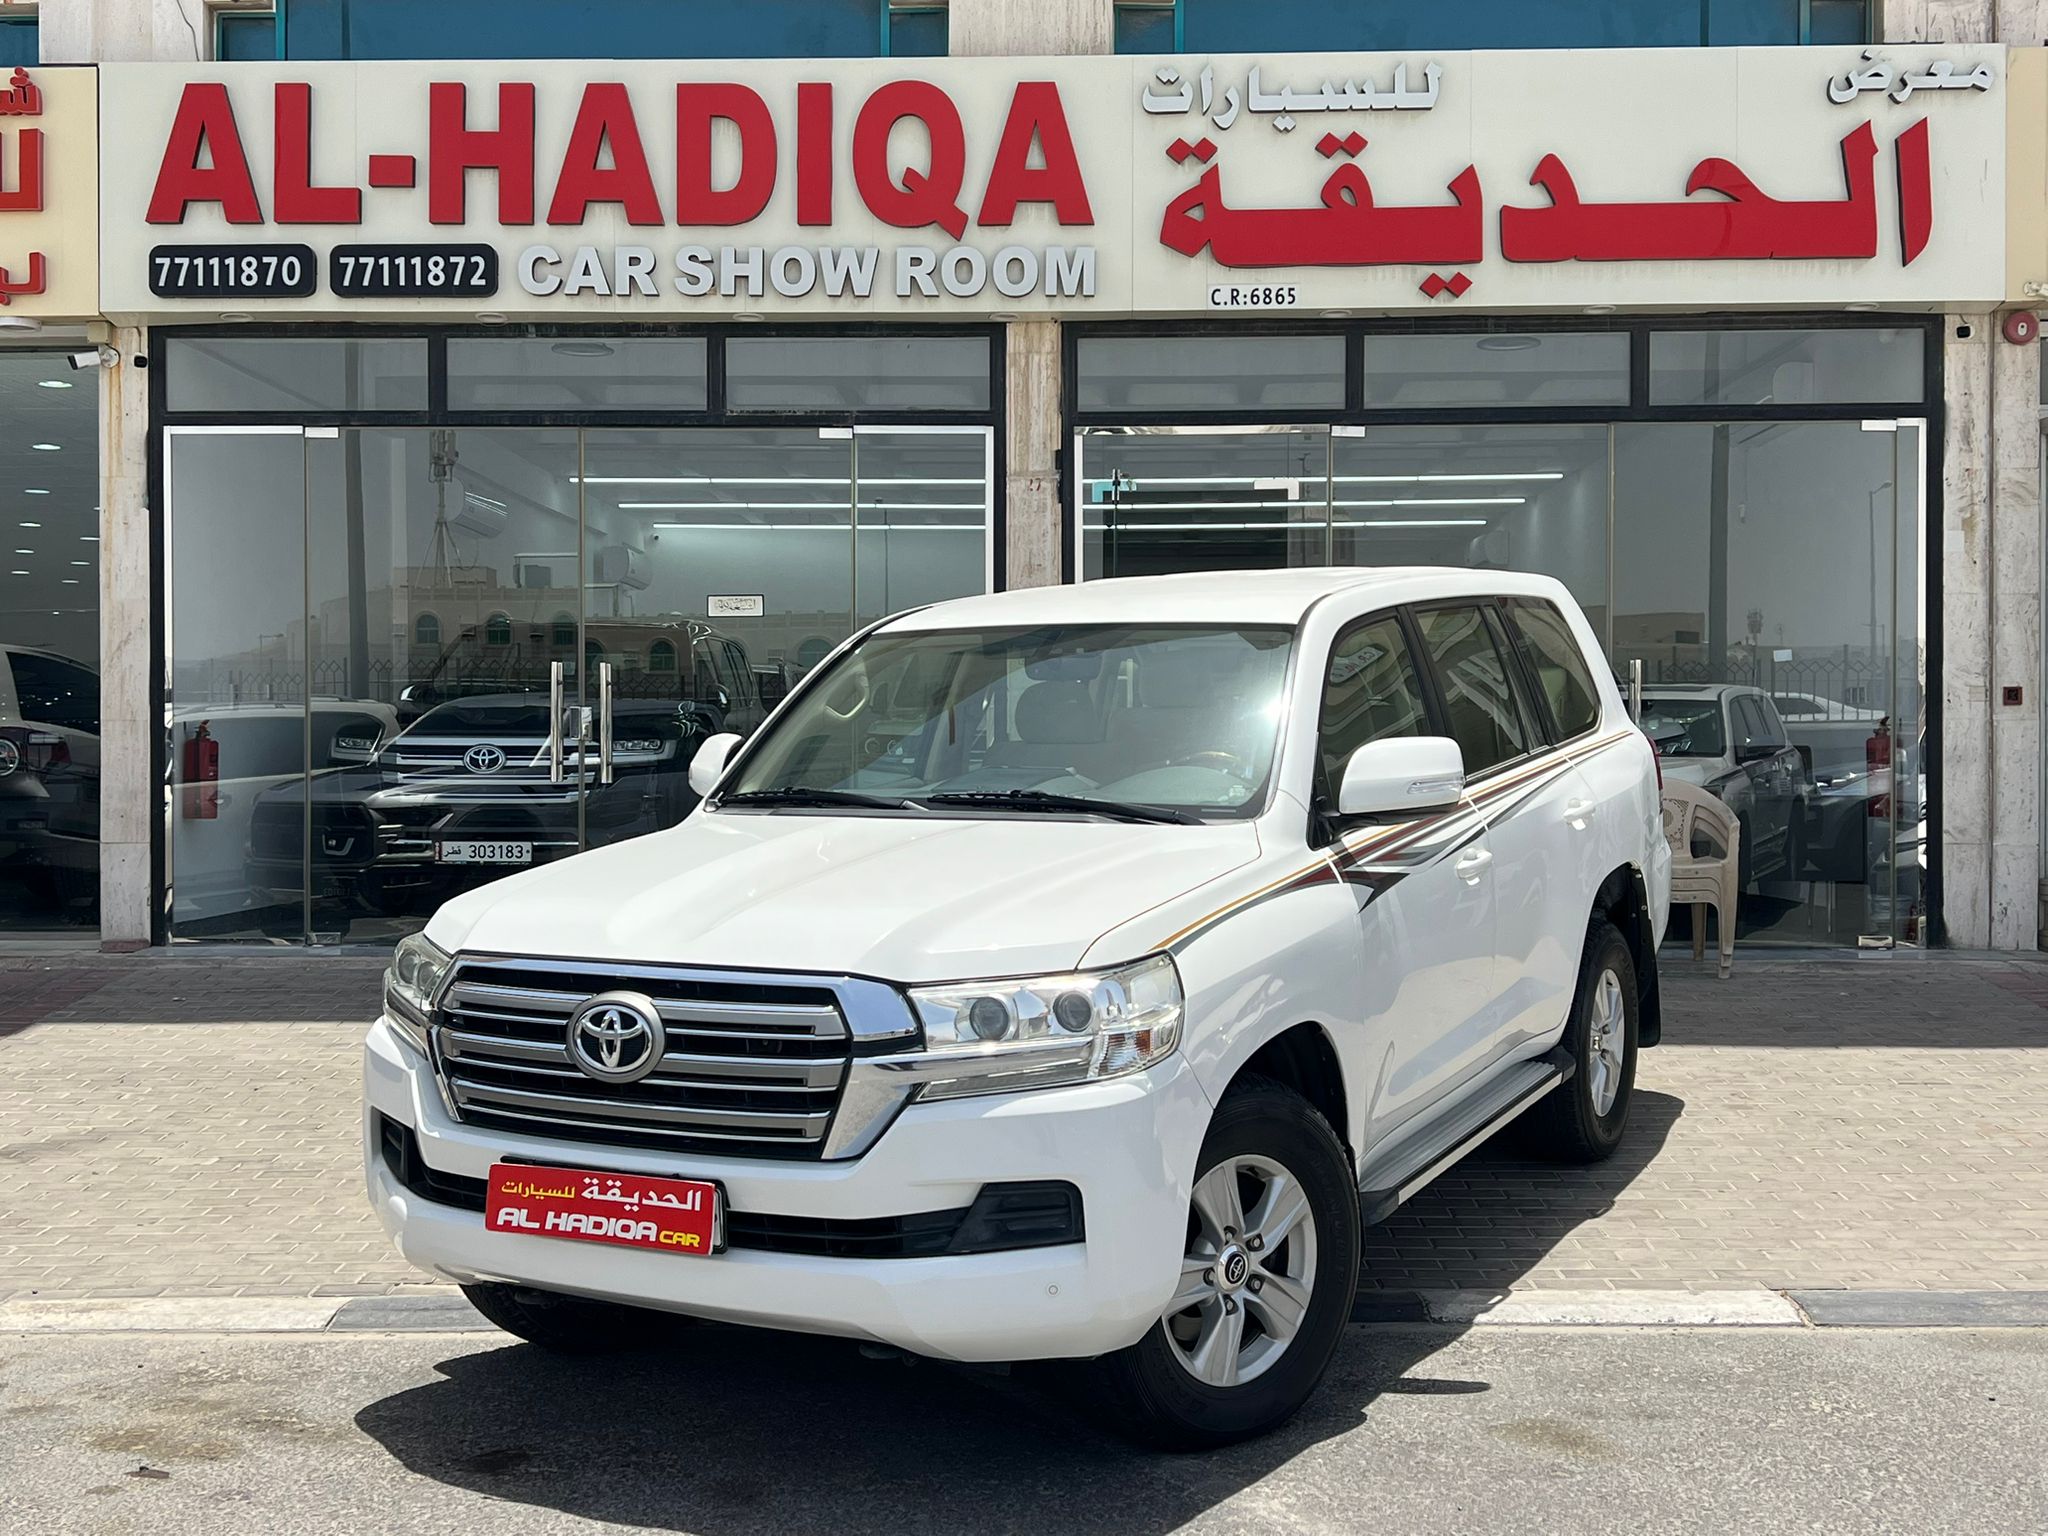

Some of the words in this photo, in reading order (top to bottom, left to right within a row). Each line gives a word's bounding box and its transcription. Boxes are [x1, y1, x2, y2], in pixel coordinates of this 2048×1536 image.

[1827, 50, 1993, 105] معرض
[1142, 61, 1442, 132] للسيارات
[146, 80, 1095, 240] AL-HADIQA
[1160, 116, 1933, 298] الحديقة
[155, 256, 301, 287] 77111870
[339, 256, 486, 287] 77111872
[517, 245, 659, 297] CAR
[674, 245, 879, 297] SHOW
[896, 246, 1097, 298] ROOM
[1210, 287, 1297, 306] C.R:6865
[443, 845, 462, 858] قطر
[468, 844, 524, 859] 303183
[501, 1181, 576, 1200] للسيارات
[581, 1177, 702, 1212] الحديقة
[496, 1207, 540, 1229] AL
[545, 1211, 658, 1242] HADIQA
[659, 1230, 700, 1248] CAR
